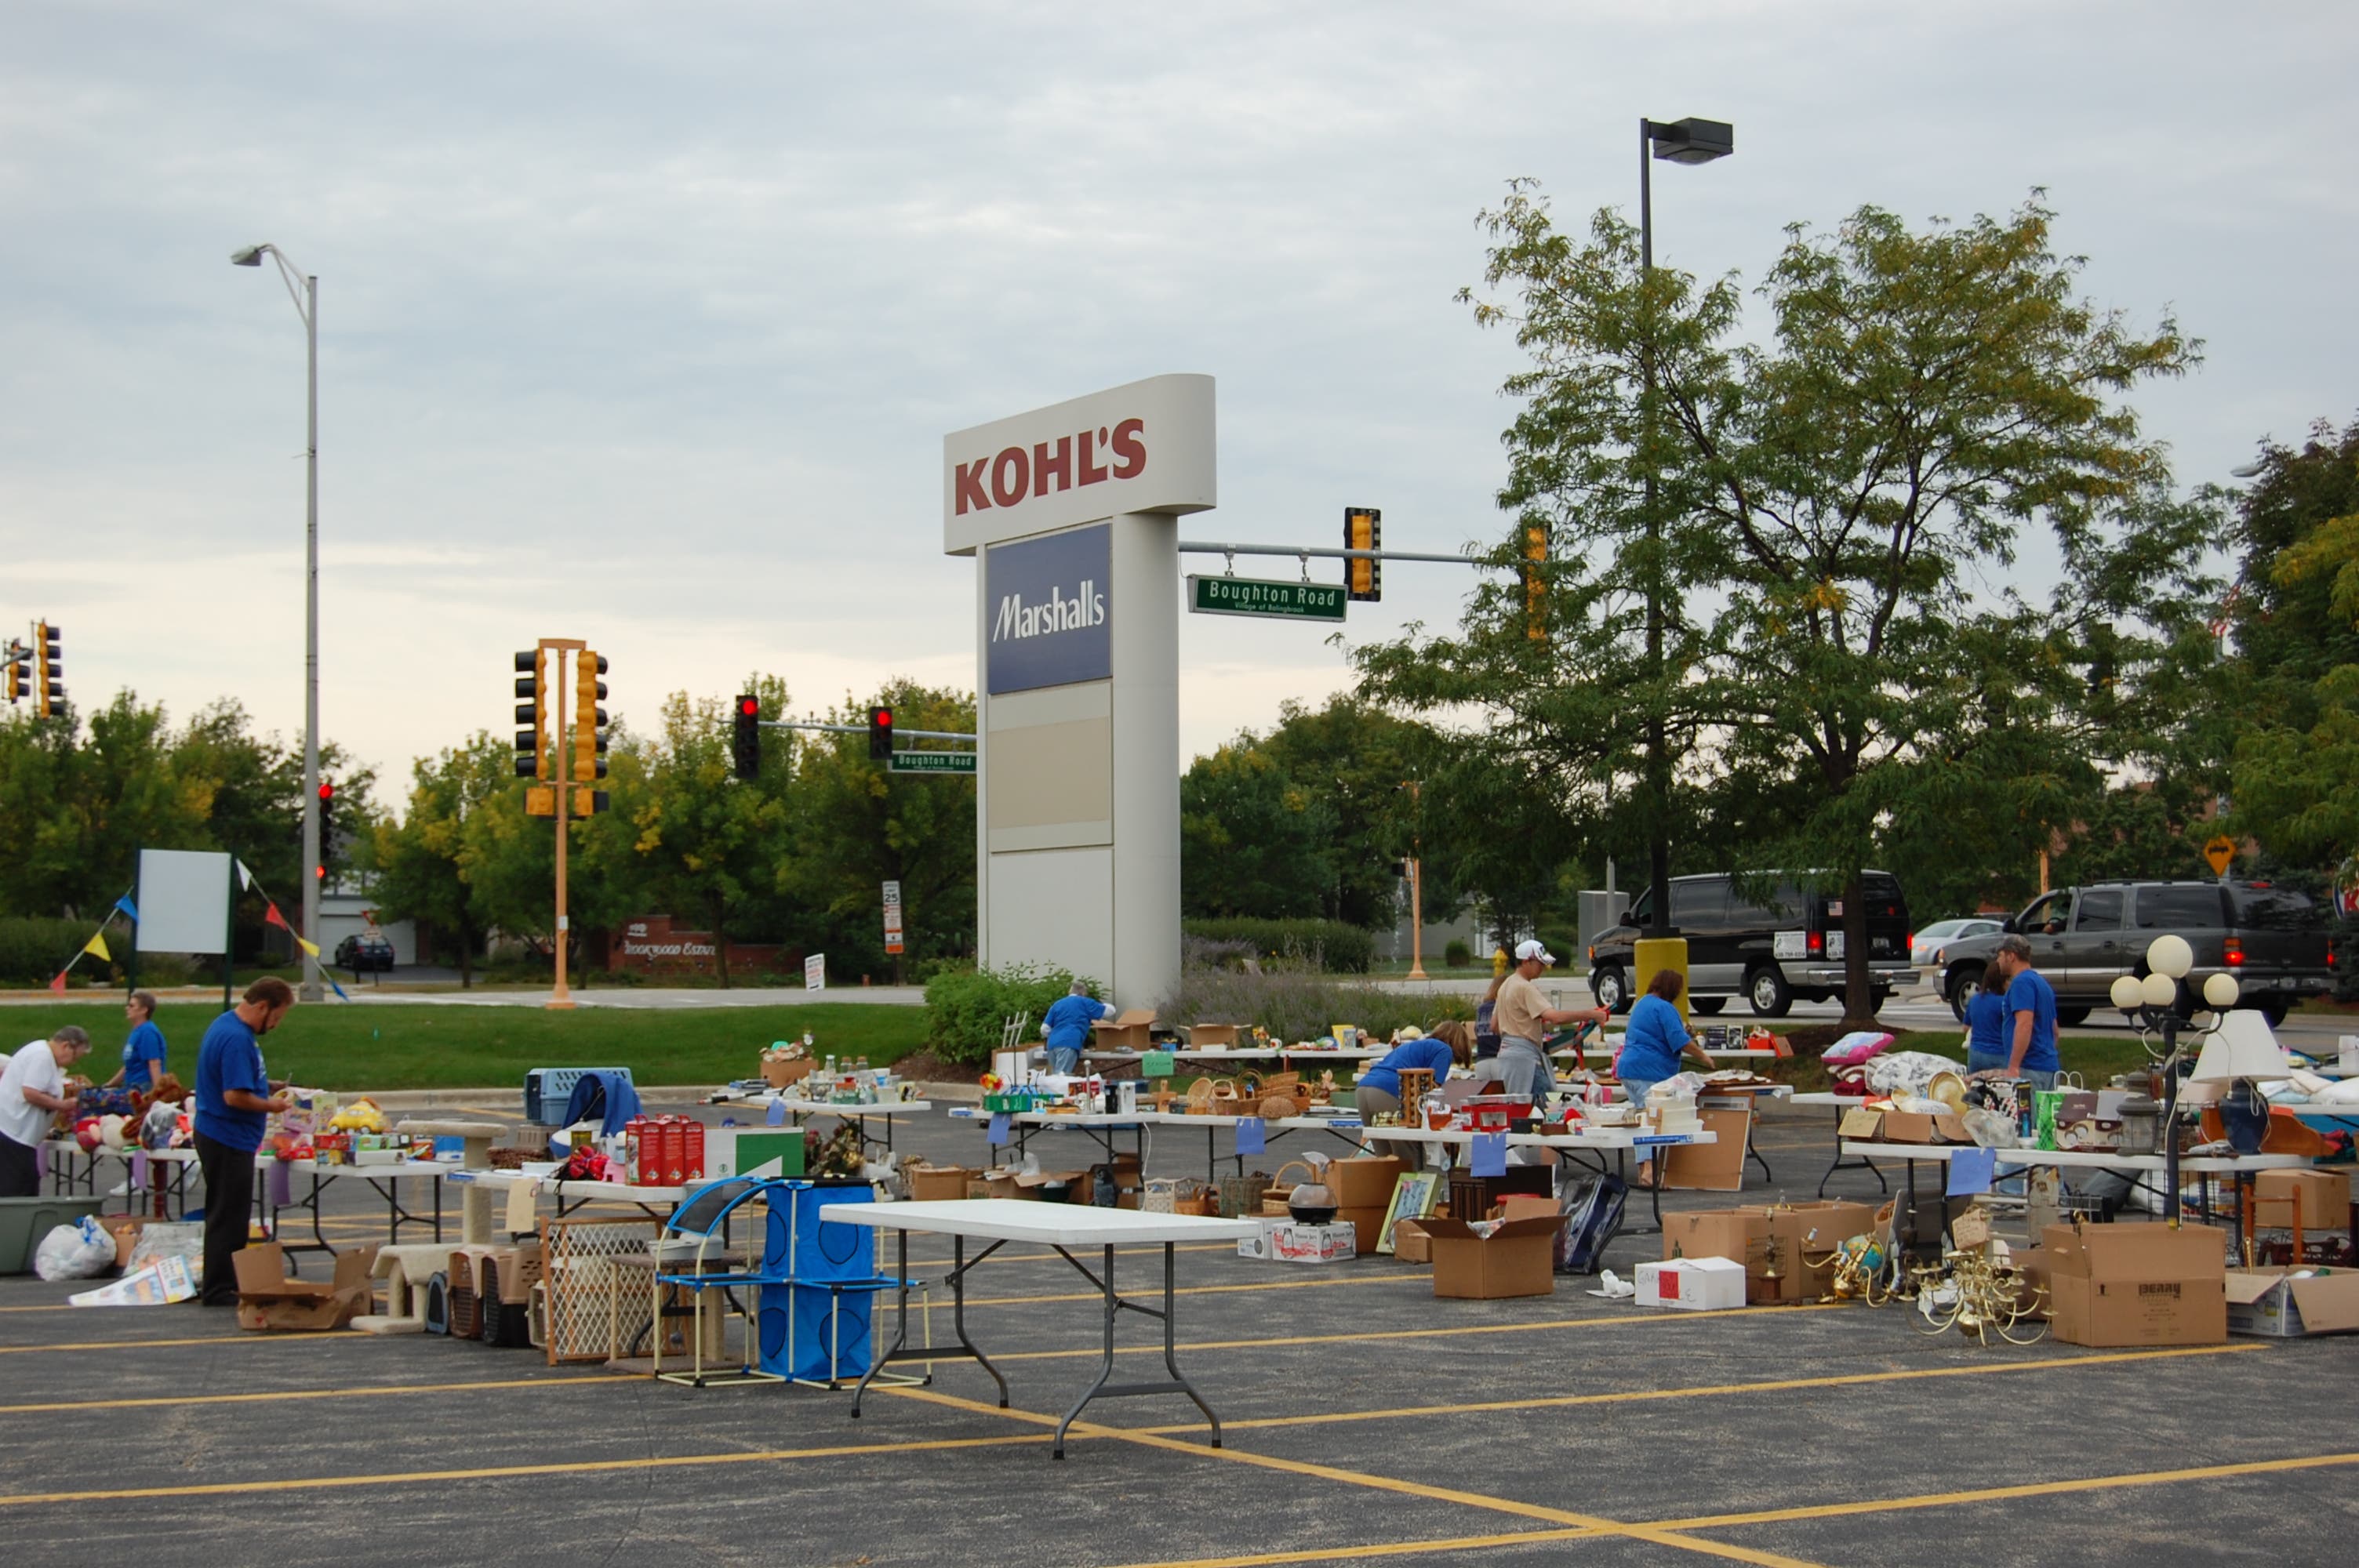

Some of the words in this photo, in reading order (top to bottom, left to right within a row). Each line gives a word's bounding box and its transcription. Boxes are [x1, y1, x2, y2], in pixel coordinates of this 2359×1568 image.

[955, 417, 1147, 516] KOHL'S
[1209, 581, 1289, 604] Boughton
[1297, 587, 1336, 606] Road
[993, 579, 1105, 643] Marshalls
[1234, 601, 1256, 612] Village
[899, 754, 945, 766] Boughton
[948, 756, 972, 766] Road
[885, 894, 899, 903] 25
